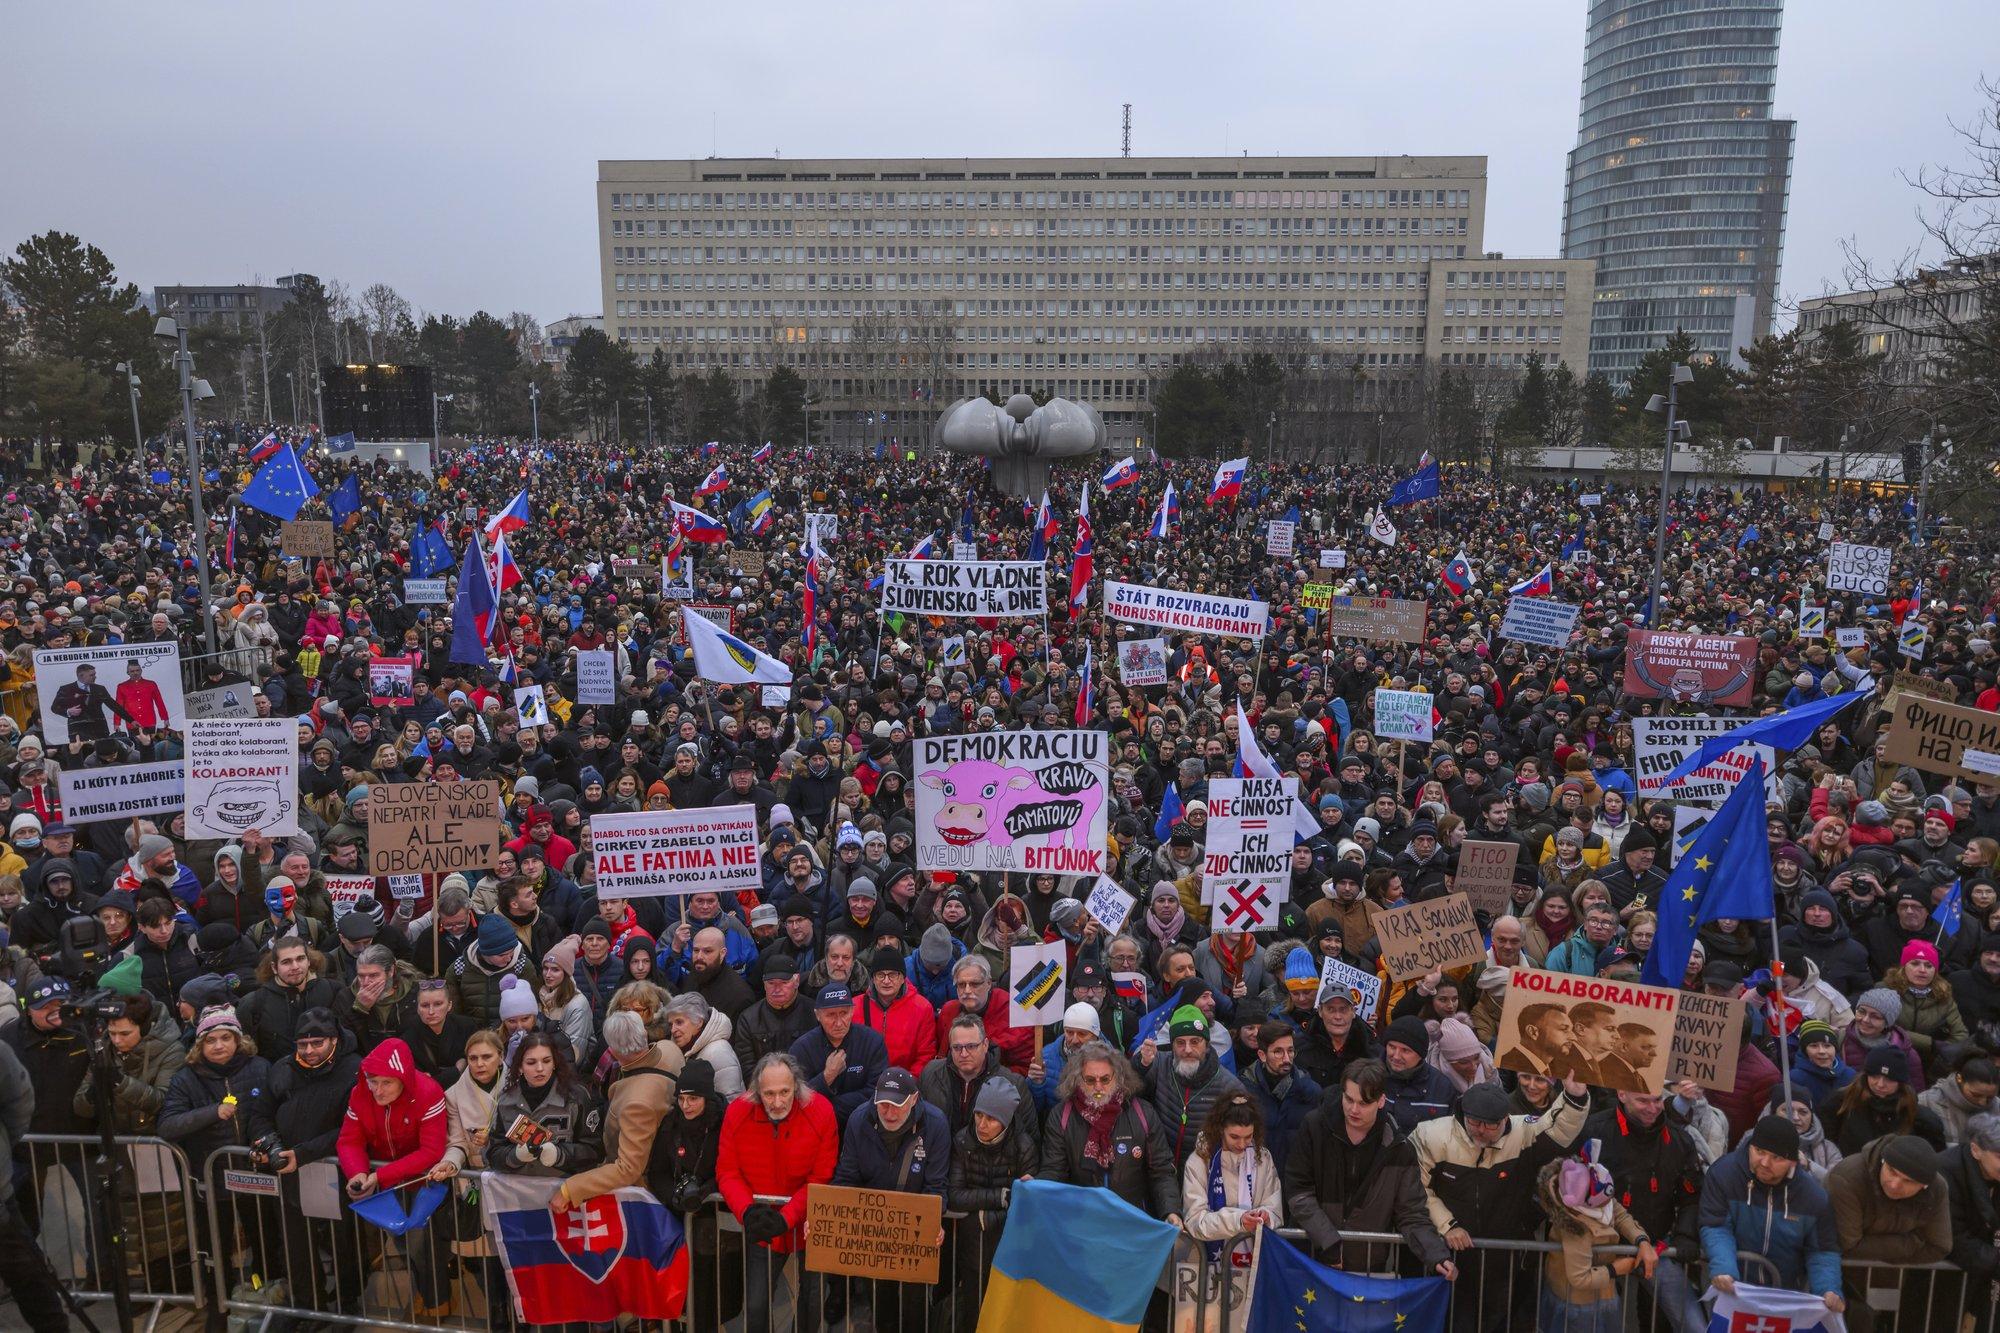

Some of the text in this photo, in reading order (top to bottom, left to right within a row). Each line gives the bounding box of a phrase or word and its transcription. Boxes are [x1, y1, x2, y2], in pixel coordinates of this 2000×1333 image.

[890, 563, 1042, 588] 14. ROK VLÁDNE
[1830, 575, 1886, 594] PUCO
[885, 586, 1042, 613] SLOVENSKO JE NA DNE
[1116, 587, 1250, 618] ŠTÁT ROZVRACAJÚ
[1108, 603, 1262, 635] PRORUSKÍ KOLABORANTI
[54, 652, 90, 662] NEBUDEM
[92, 648, 118, 659] ŽIADNY
[120, 646, 171, 658] PODRŽTAŠKA!
[1650, 636, 1736, 652] RUSKÝ AGENT
[1650, 648, 1677, 656] LOBUJE
[1690, 649, 1720, 659] KRVAVÝ
[1721, 652, 1740, 660] PLYN
[1658, 658, 1692, 668] ADOLFA
[1694, 660, 1728, 670] PUTINA
[1132, 675, 1166, 684] PUTINOVI?
[234, 720, 262, 729] vyzerá
[1648, 720, 1717, 731] MOHLI
[1906, 703, 1973, 745] ФИЦО,
[239, 738, 288, 746] kolaborant,
[925, 733, 1098, 764] DEMOKRACIU
[1646, 734, 1688, 746] SEM
[192, 766, 282, 778] KOLABORANT
[1638, 750, 1684, 774] FICO
[74, 770, 176, 790] AJ KÚTY A ZÁHORIE
[1038, 764, 1094, 790] KRAVU
[373, 784, 488, 804] SLOVENSKO
[1242, 779, 1283, 798] NAŠA
[1672, 783, 1726, 800] RICHTER
[70, 796, 158, 817] A MUSIA ZOSTAŤ
[374, 801, 496, 824] NEPATRÍ VLÁDE,
[1209, 796, 1294, 817] NEČINNOSŤ
[594, 830, 624, 838] DIABOL
[662, 824, 695, 834] CHYSTÁ
[711, 821, 754, 831] VATIKÁNU
[1006, 804, 1084, 835] ZAMATOVÚ
[407, 823, 462, 846] ALE
[595, 830, 753, 852] CIRKEV ZBABELO MLČÍ
[1242, 834, 1268, 852] ICH
[376, 844, 490, 871] OBČANOM!
[598, 846, 756, 874] ALE FATIMA NIE
[920, 844, 1102, 874] VEDÚ NA BITÚNOK
[1205, 850, 1292, 876] ZLOČINNOSŤ
[1470, 848, 1507, 864] FICO
[390, 874, 420, 885] MY SME
[599, 868, 756, 888] TÁ PRINÁŠA POKOJ A LÁSKU
[393, 885, 421, 896] EURÓPA
[1379, 910, 1422, 940] VRAJ
[1389, 928, 1477, 975] SKÔR SOCIOPAT
[1326, 969, 1337, 978] JE
[1328, 960, 1378, 986] SLOVENSKO
[1020, 964, 1060, 1006] MIER UKRAJINE
[1512, 971, 1674, 1012] KOLABORANTI
[1673, 1036, 1724, 1060] RUSKÝ
[1676, 1060, 1716, 1081] PLYN
[814, 1204, 832, 1216] MY
[832, 1206, 860, 1220] VIEME
[864, 1208, 884, 1222] KTO
[888, 1211, 910, 1225] STE
[814, 1220, 834, 1233] STE
[840, 1220, 861, 1236] PLNÍ
[860, 1224, 909, 1240] NENÁVISTI
[812, 1234, 832, 1248] STE
